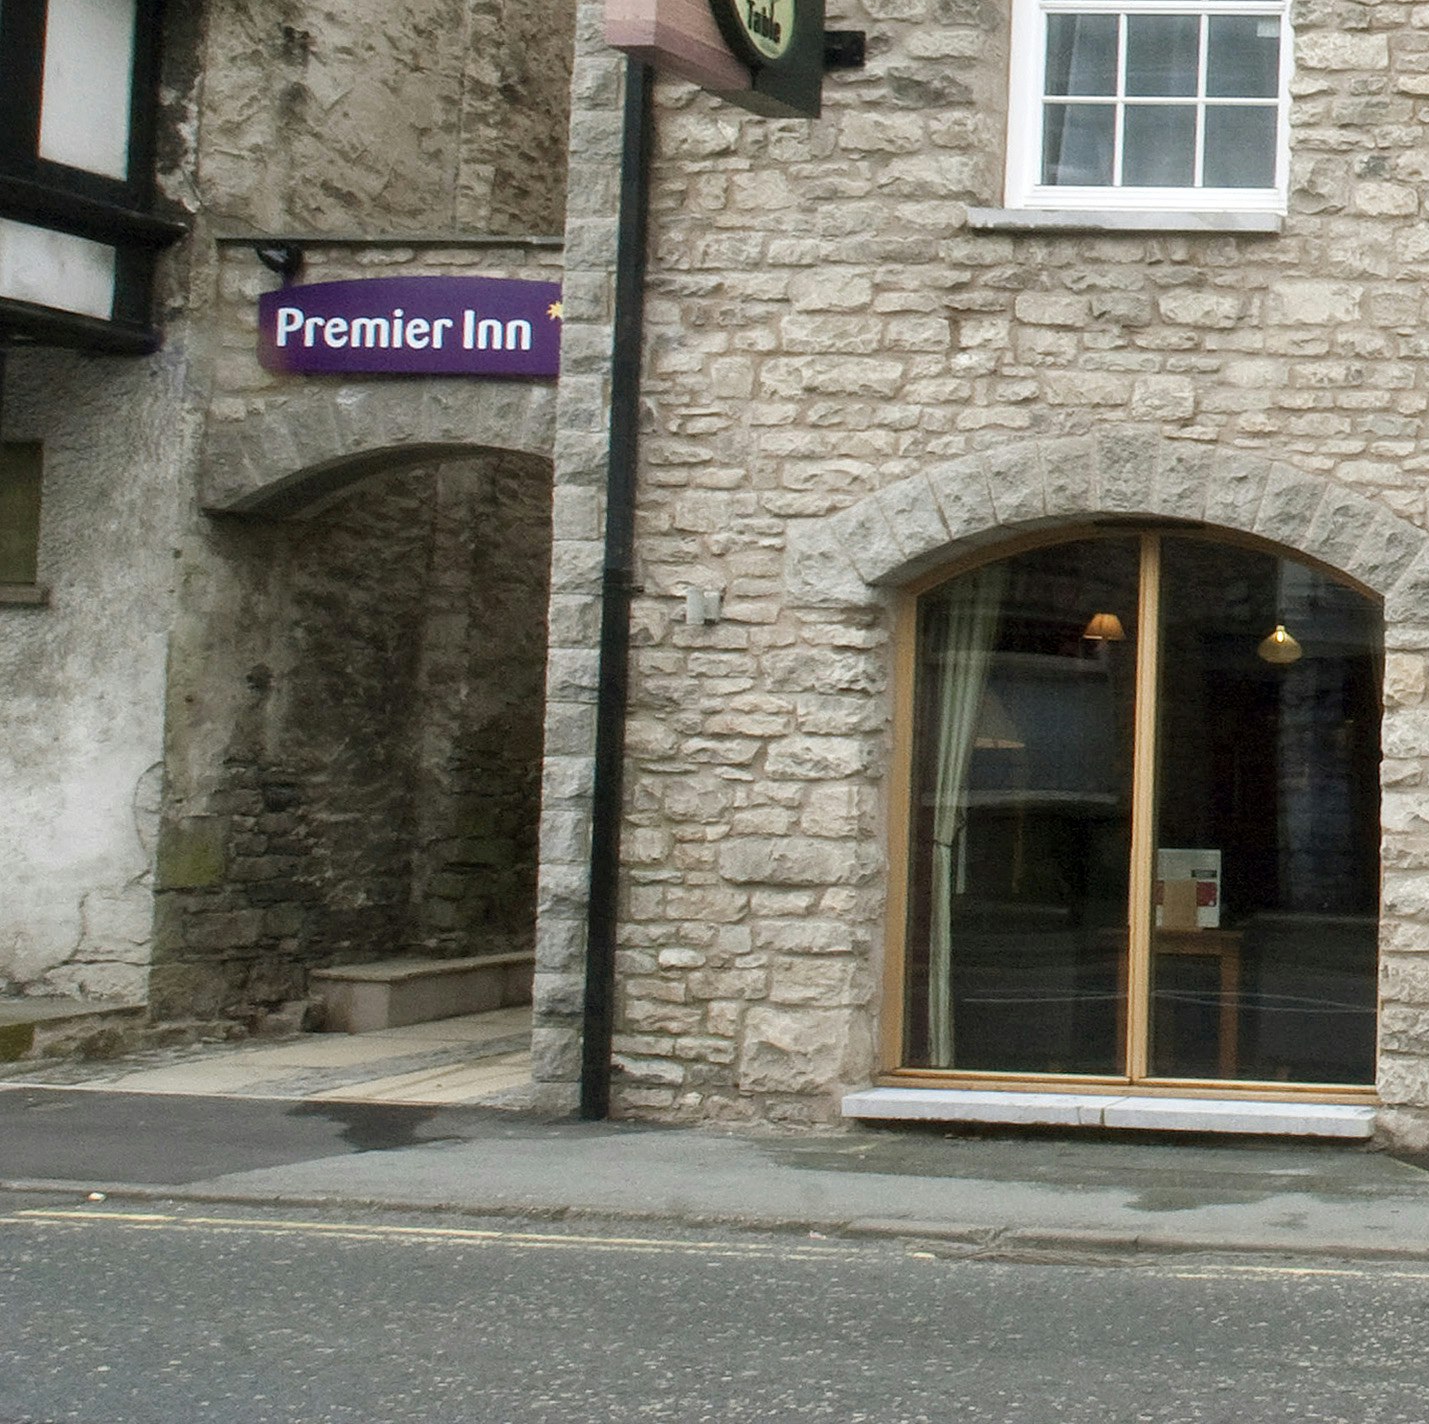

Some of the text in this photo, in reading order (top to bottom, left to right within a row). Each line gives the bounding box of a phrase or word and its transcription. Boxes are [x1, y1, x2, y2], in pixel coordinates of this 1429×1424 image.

[747, 0, 781, 43] Table
[276, 307, 532, 351] Premier Inn
